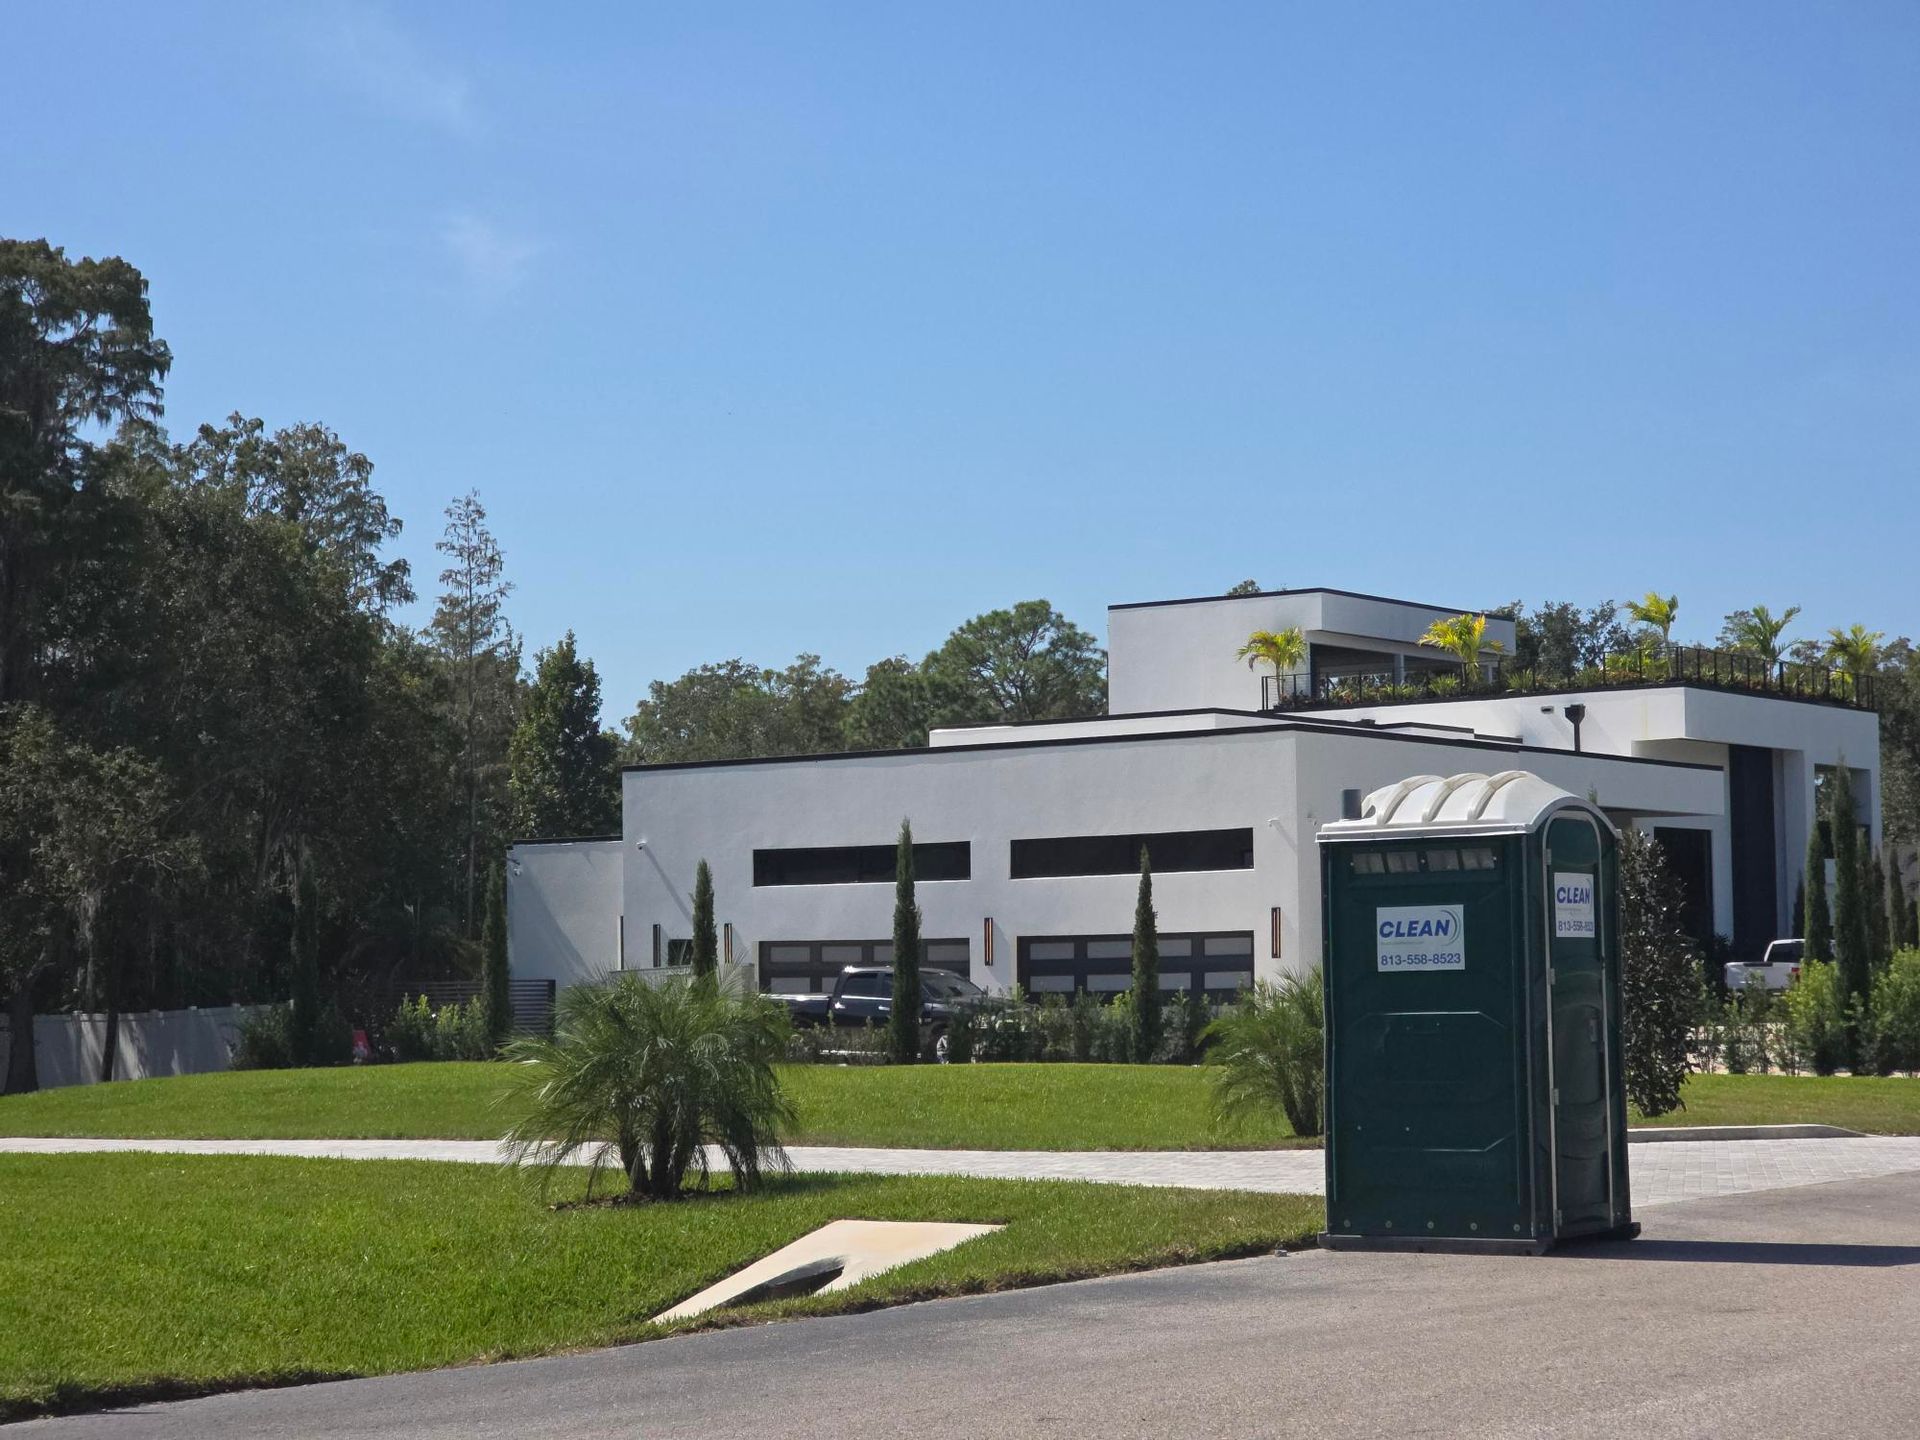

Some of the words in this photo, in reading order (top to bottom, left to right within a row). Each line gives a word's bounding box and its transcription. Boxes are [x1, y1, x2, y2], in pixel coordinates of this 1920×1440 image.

[1557, 886, 1590, 904] CLEAN
[1379, 919, 1450, 938] CLEAN
[1558, 920, 1593, 932] 813-558-
[1381, 953, 1461, 966] 813-558-8523
